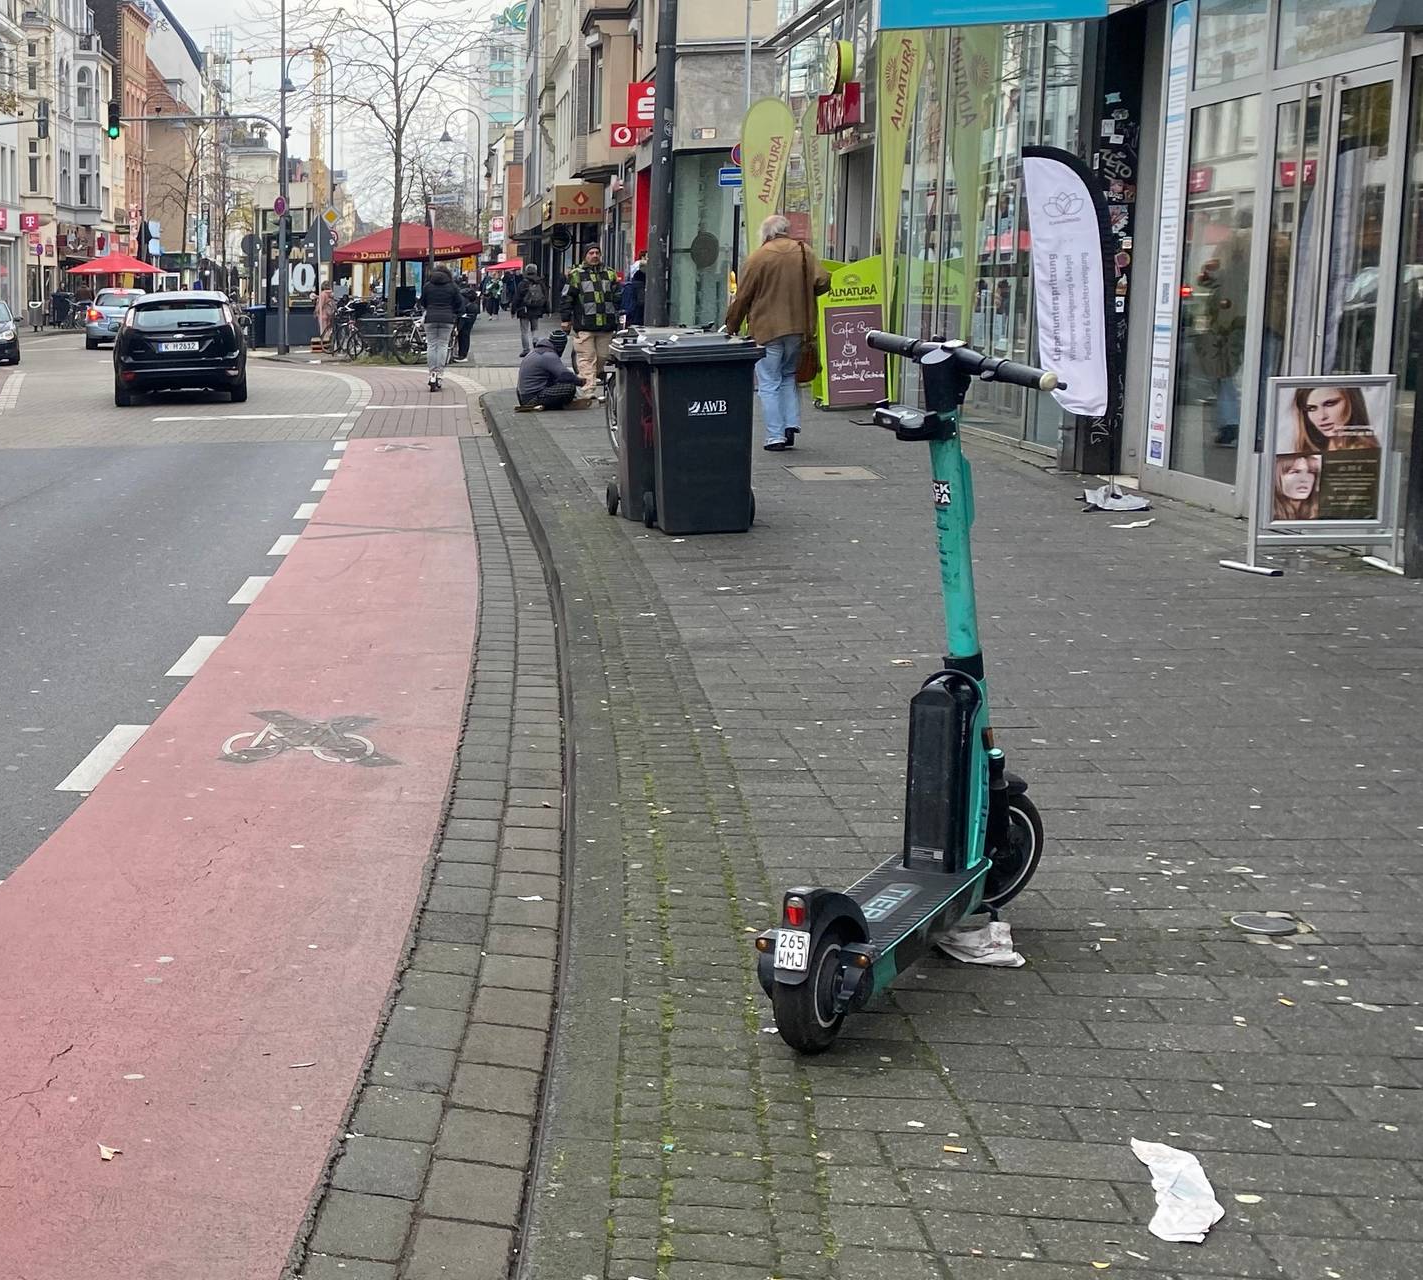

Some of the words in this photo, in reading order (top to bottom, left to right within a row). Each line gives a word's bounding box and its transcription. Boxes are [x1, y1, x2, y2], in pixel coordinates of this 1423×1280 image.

[890, 38, 913, 131] ALNATURA
[758, 135, 784, 204] ALNATURA
[559, 206, 602, 215] Damla
[827, 284, 878, 298] ALNATURA
[1048, 253, 1062, 362] Lippenunterspritzung
[831, 321, 855, 338] Café
[701, 400, 727, 412] AWB
[933, 483, 951, 494] CK
[780, 933, 805, 950] 265
[778, 951, 804, 968] WMJ
